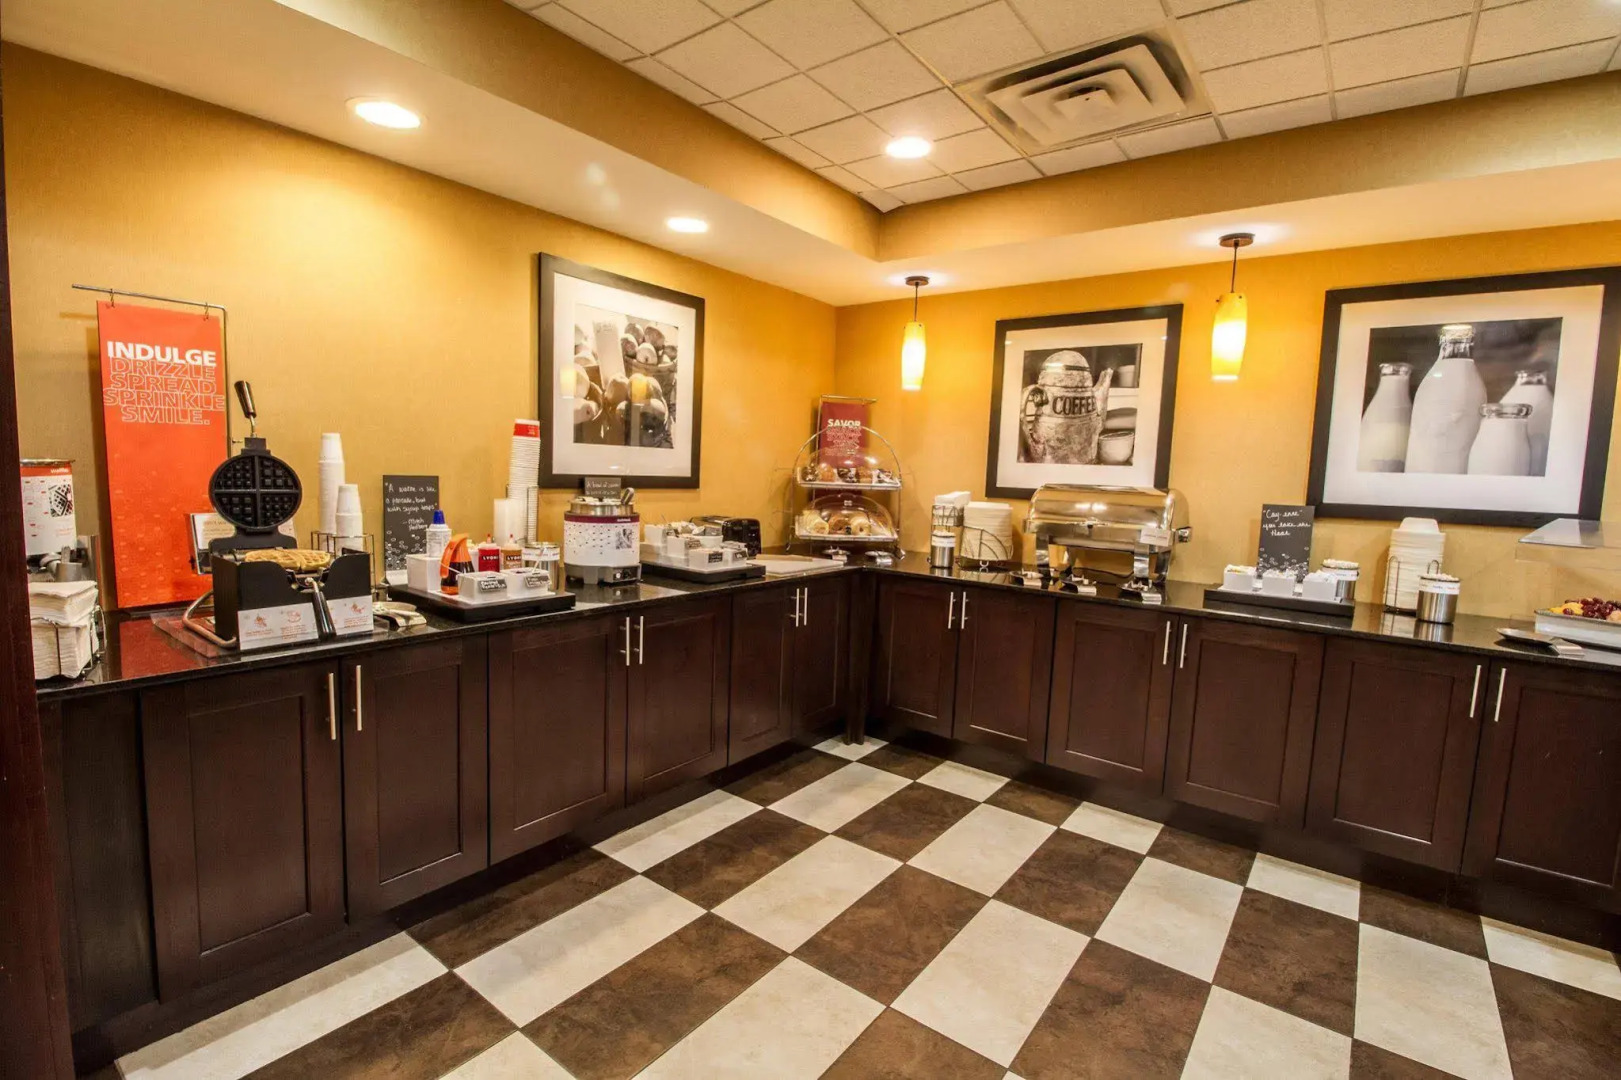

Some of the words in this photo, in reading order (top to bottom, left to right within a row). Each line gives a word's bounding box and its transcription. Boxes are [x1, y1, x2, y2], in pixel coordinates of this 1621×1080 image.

[106, 341, 217, 367] INDULGE
[110, 357, 216, 381] DRIZZLE
[110, 373, 217, 394] SPREAD
[103, 388, 225, 411] SPRINKLE
[120, 404, 211, 425] SMILE.
[827, 418, 861, 428] SAVOR
